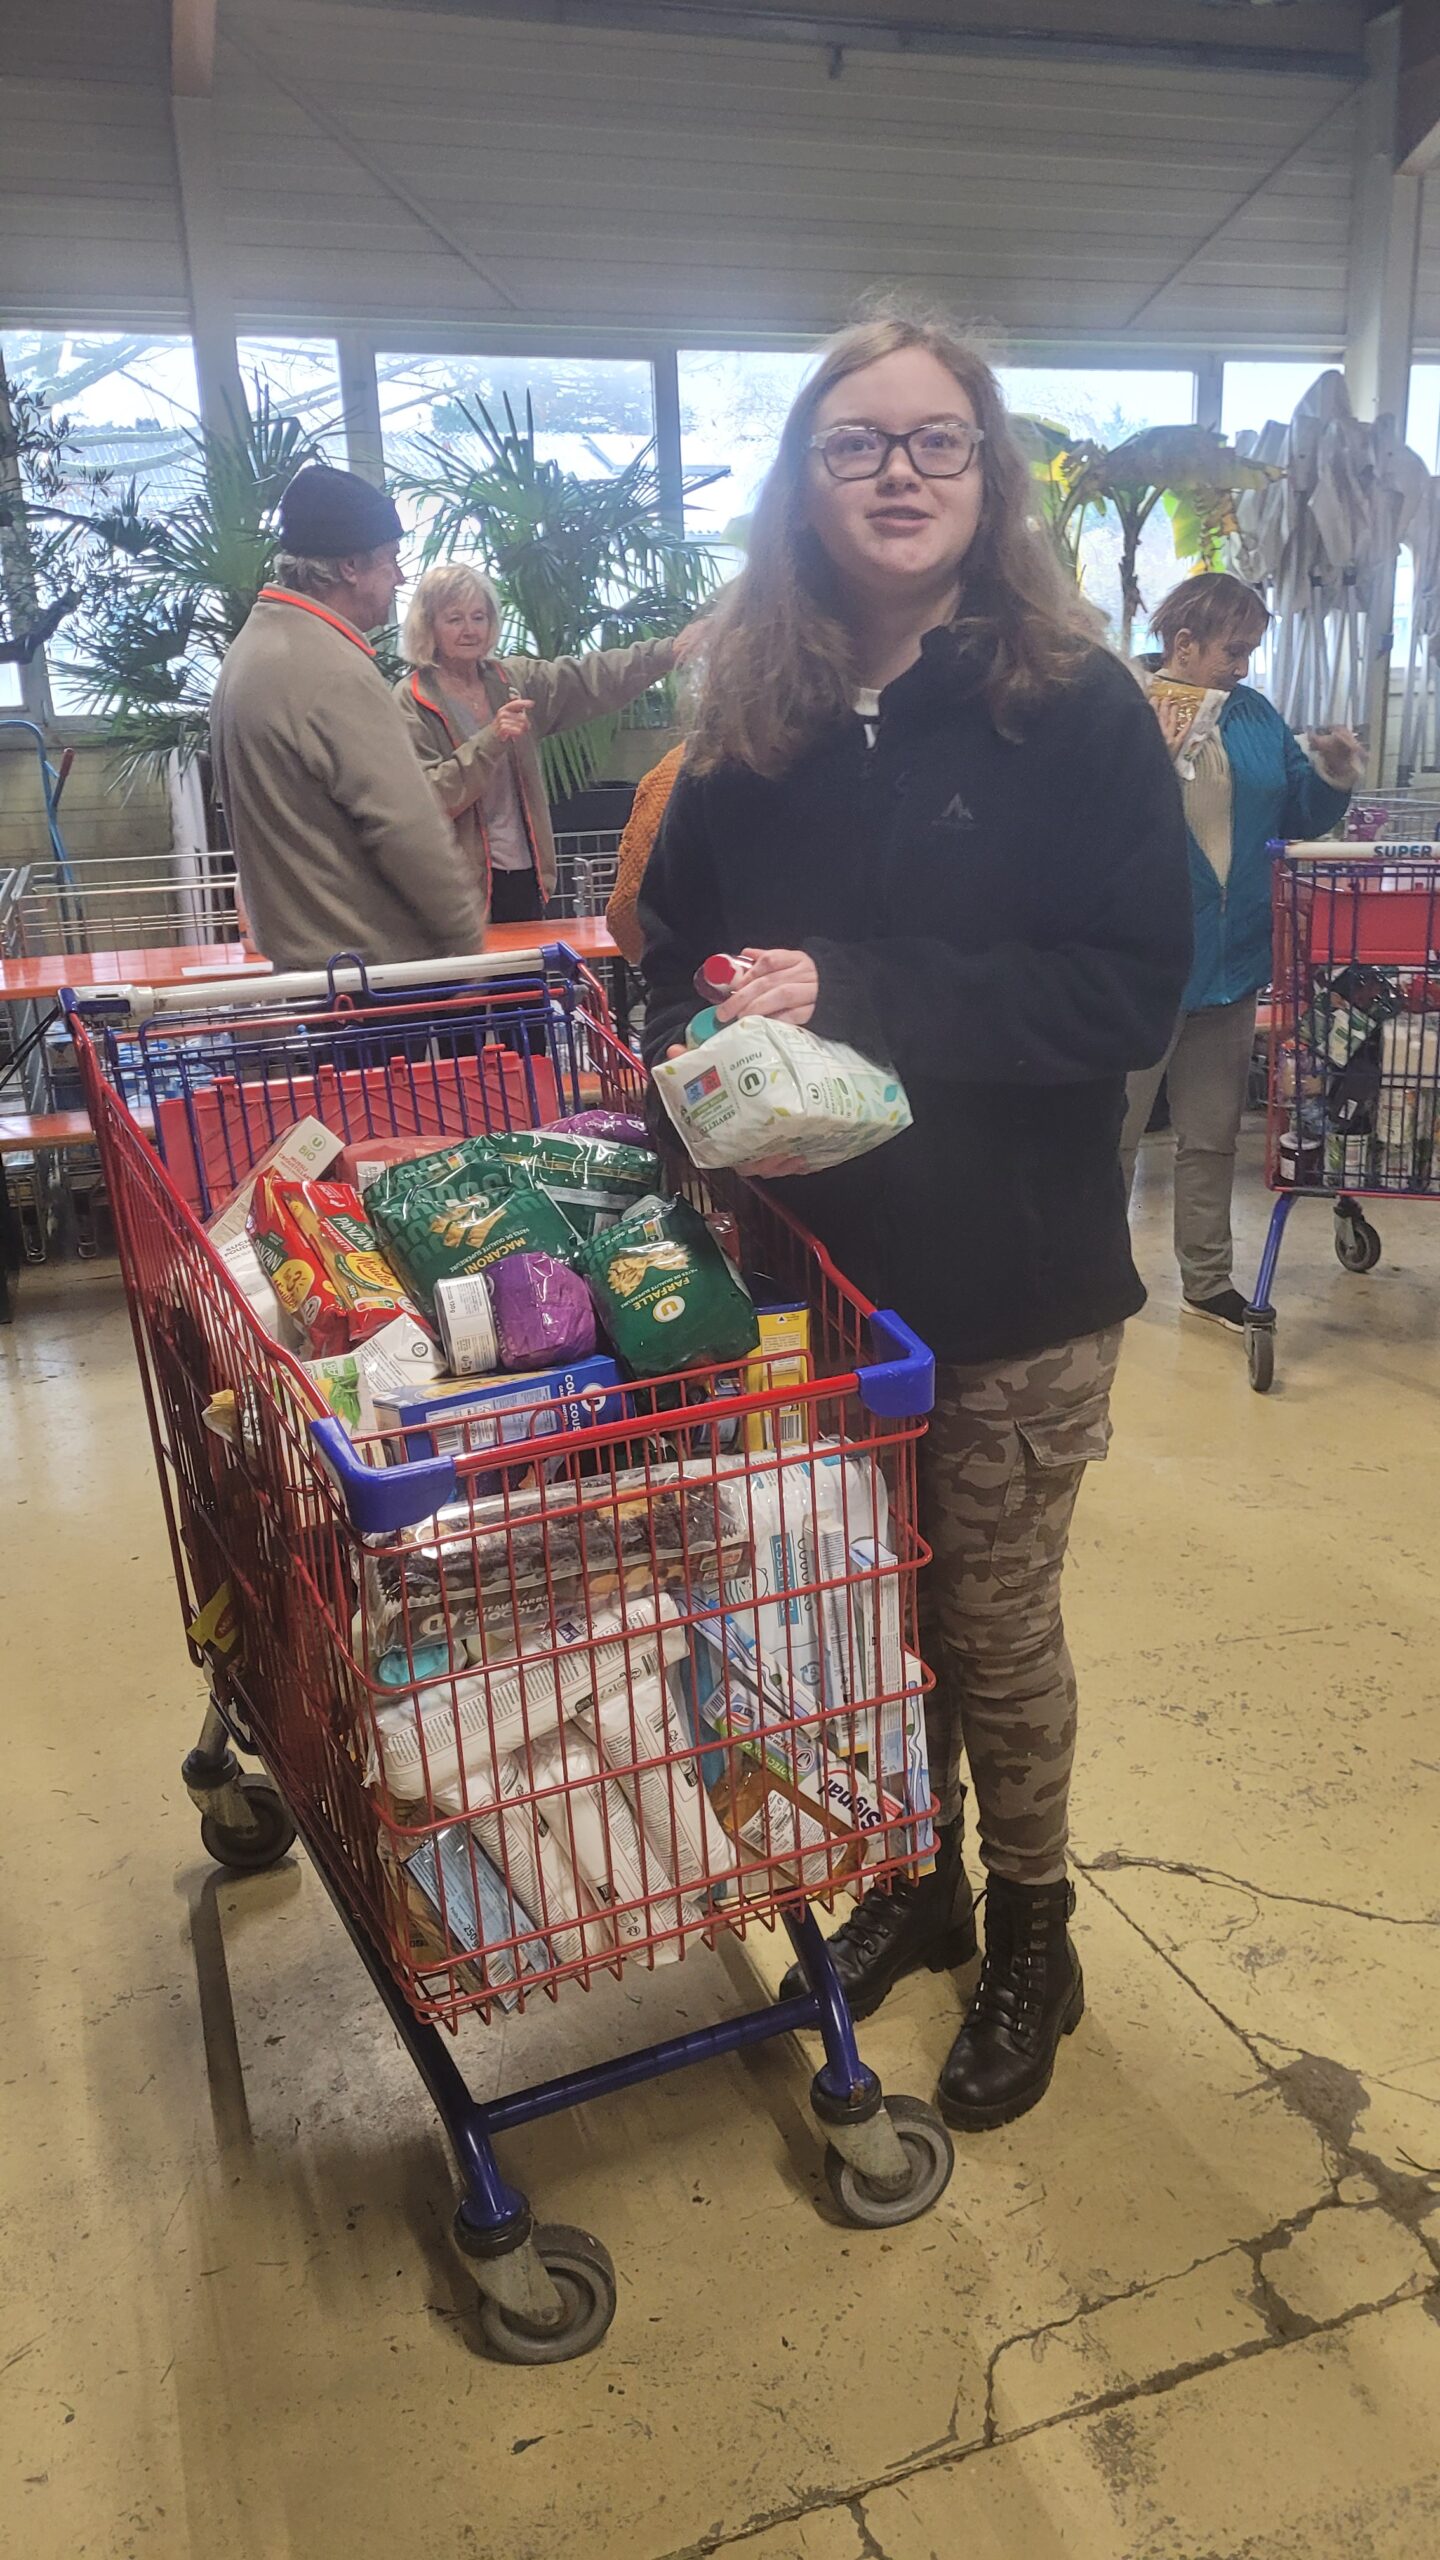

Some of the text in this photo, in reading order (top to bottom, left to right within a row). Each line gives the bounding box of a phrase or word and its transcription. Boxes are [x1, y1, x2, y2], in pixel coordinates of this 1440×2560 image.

[1373, 845, 1433, 858] SUPER
[730, 1051, 763, 1071] nature
[298, 1145, 317, 1161] BIO
[333, 1217, 378, 1251] PANZANI
[464, 1237, 526, 1275] MACARONI
[634, 1276, 691, 1310] FARFALLE
[816, 1776, 882, 1833] Signal
